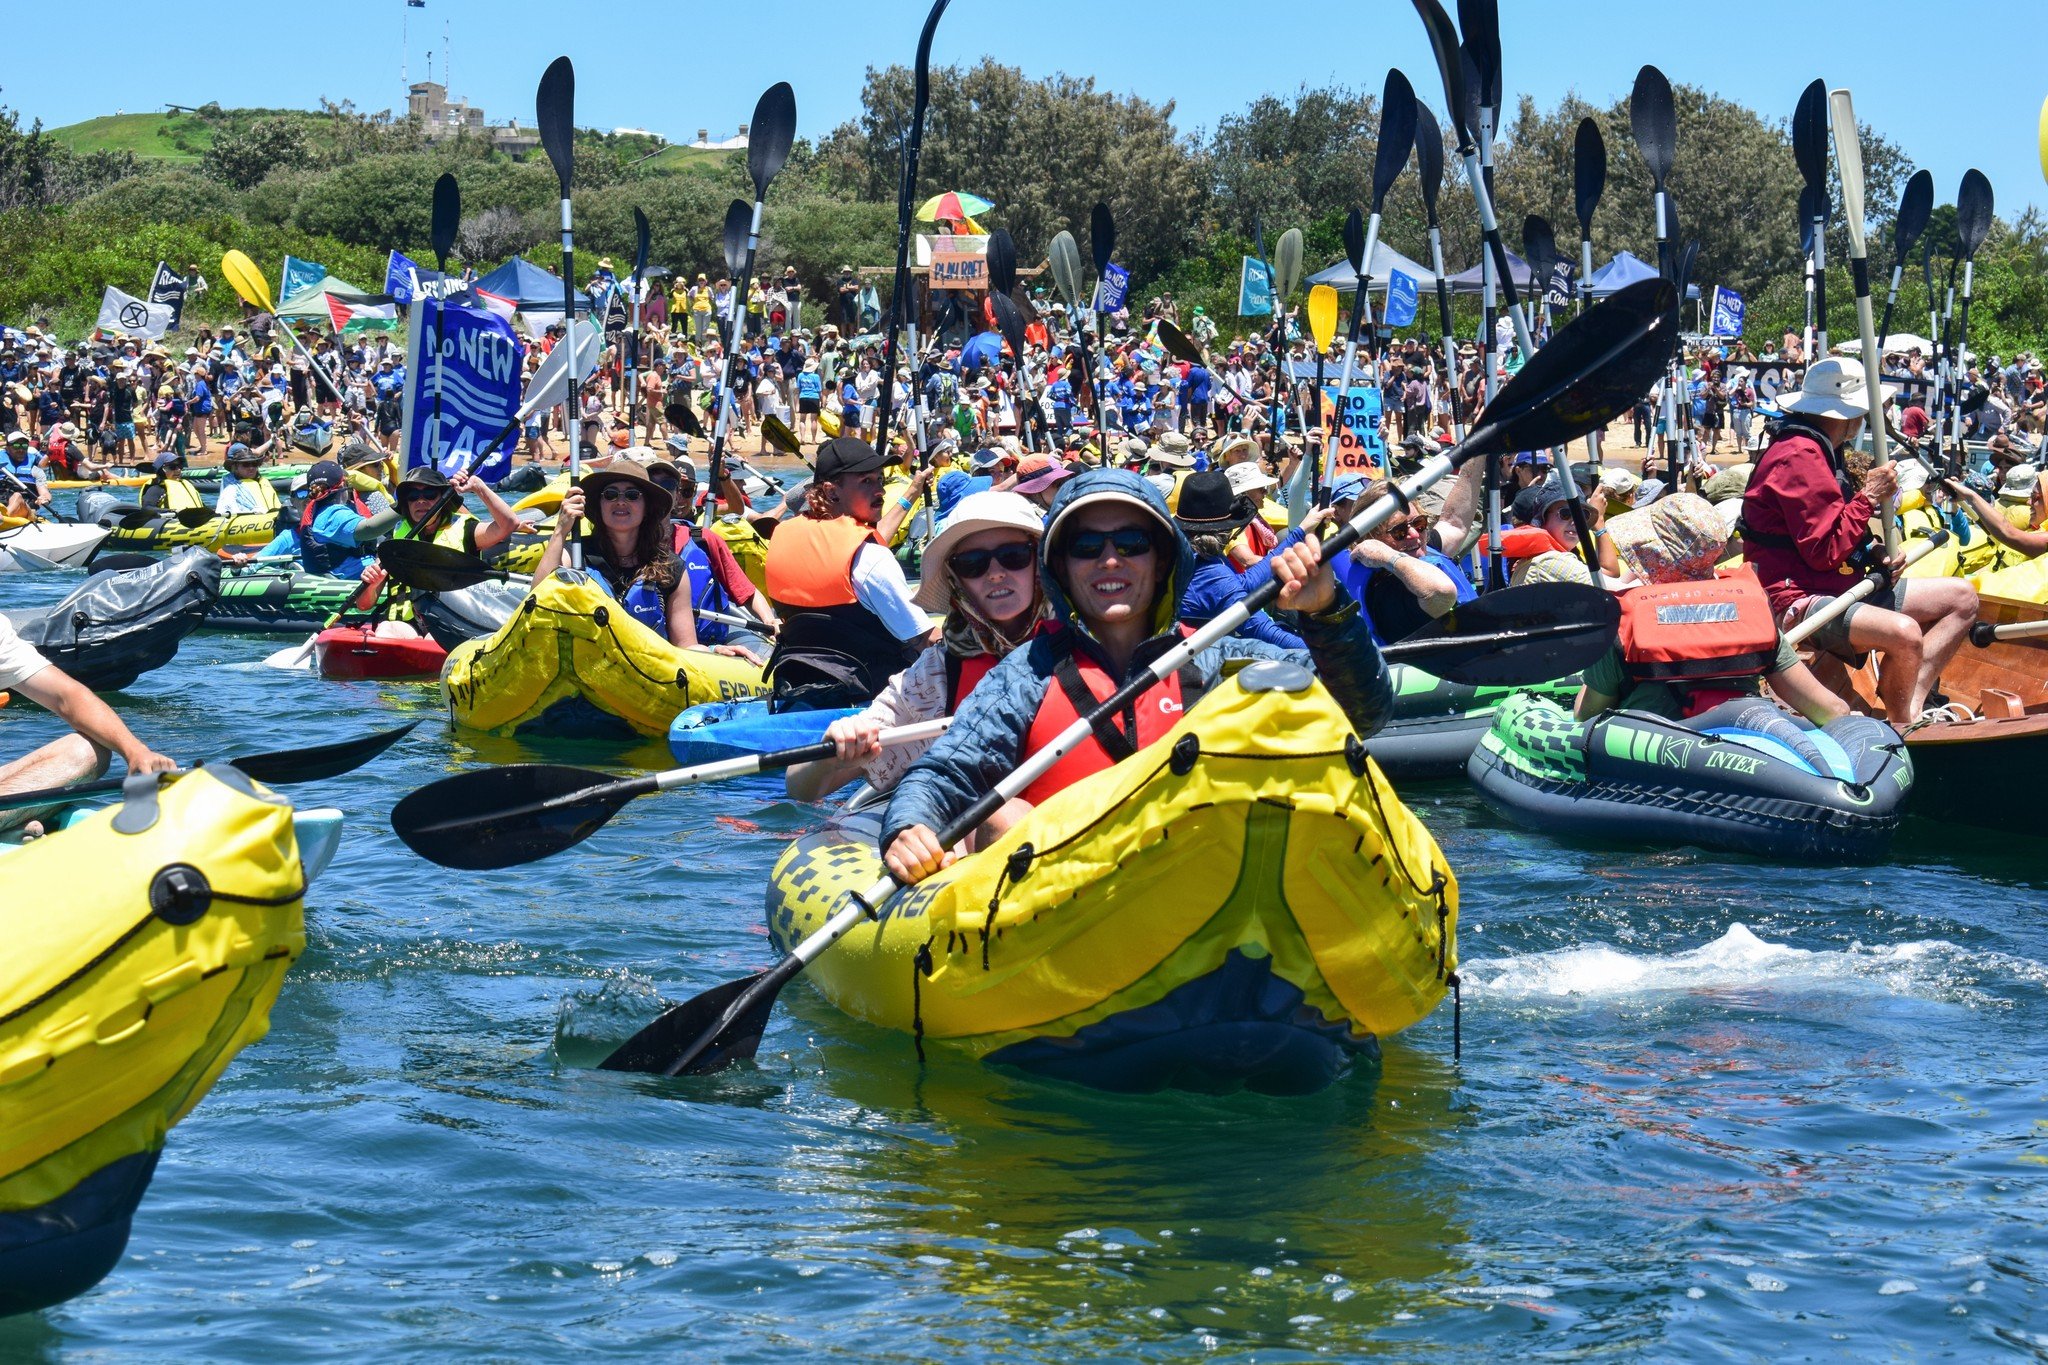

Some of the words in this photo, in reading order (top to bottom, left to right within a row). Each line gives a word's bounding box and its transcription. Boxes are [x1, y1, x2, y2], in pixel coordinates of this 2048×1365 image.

[1102, 290, 1117, 307] OAL
[1548, 290, 1569, 306] COAL
[1727, 297, 1741, 312] NEW
[1717, 313, 1737, 331] COAL
[458, 326, 514, 384] NEW
[421, 412, 504, 467] GAS
[1328, 434, 1379, 448] OAL
[1343, 453, 1381, 467] GAS
[1661, 736, 1695, 769] K1
[1705, 751, 1763, 774] INTEX
